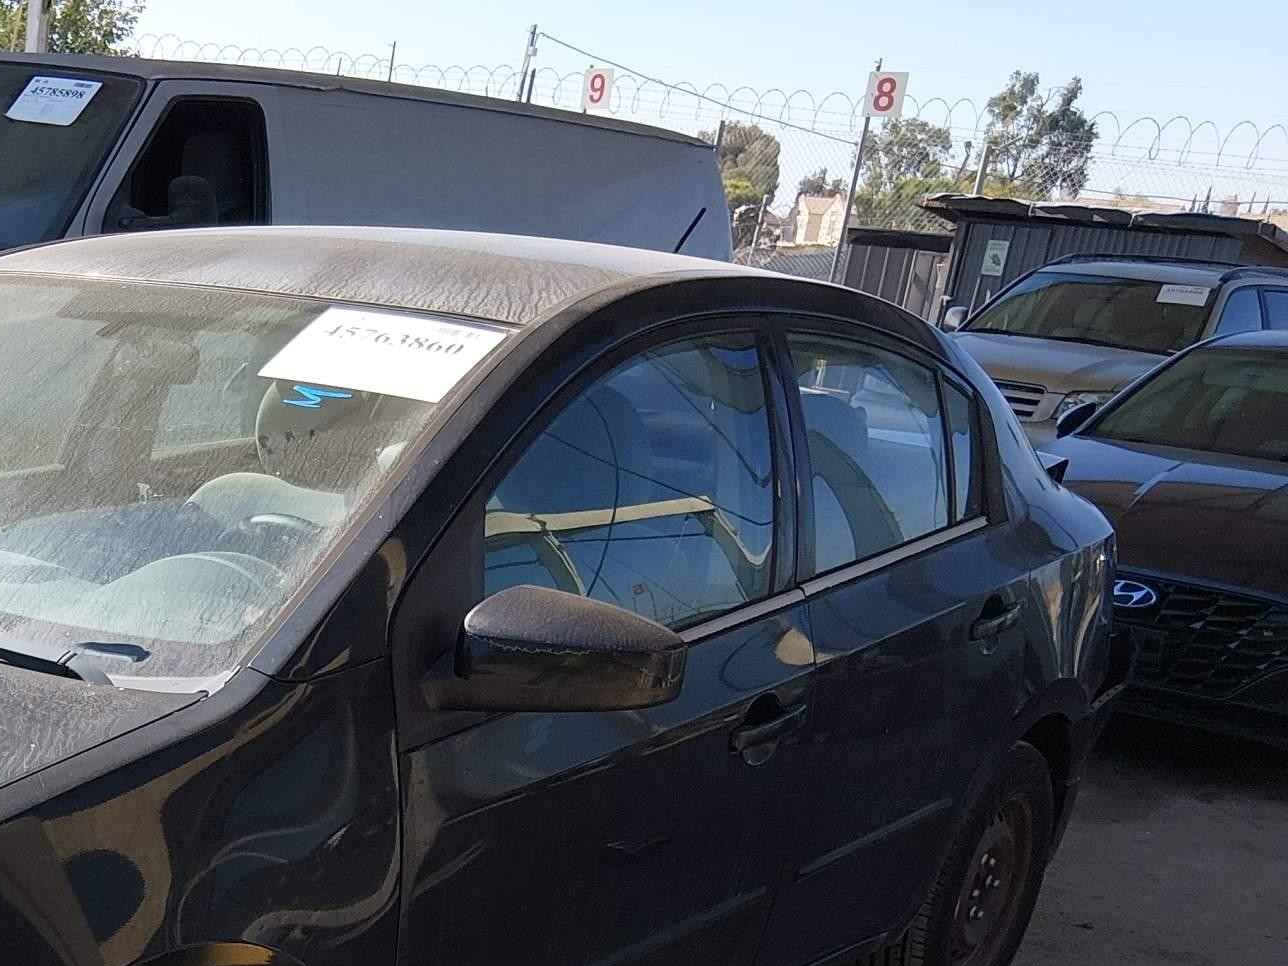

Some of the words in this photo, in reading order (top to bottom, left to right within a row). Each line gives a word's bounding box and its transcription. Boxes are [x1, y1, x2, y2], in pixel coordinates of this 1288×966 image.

[30, 86, 86, 100] 45785898
[589, 73, 606, 103] 9
[873, 77, 897, 112] 8
[323, 324, 465, 356] 45763860
